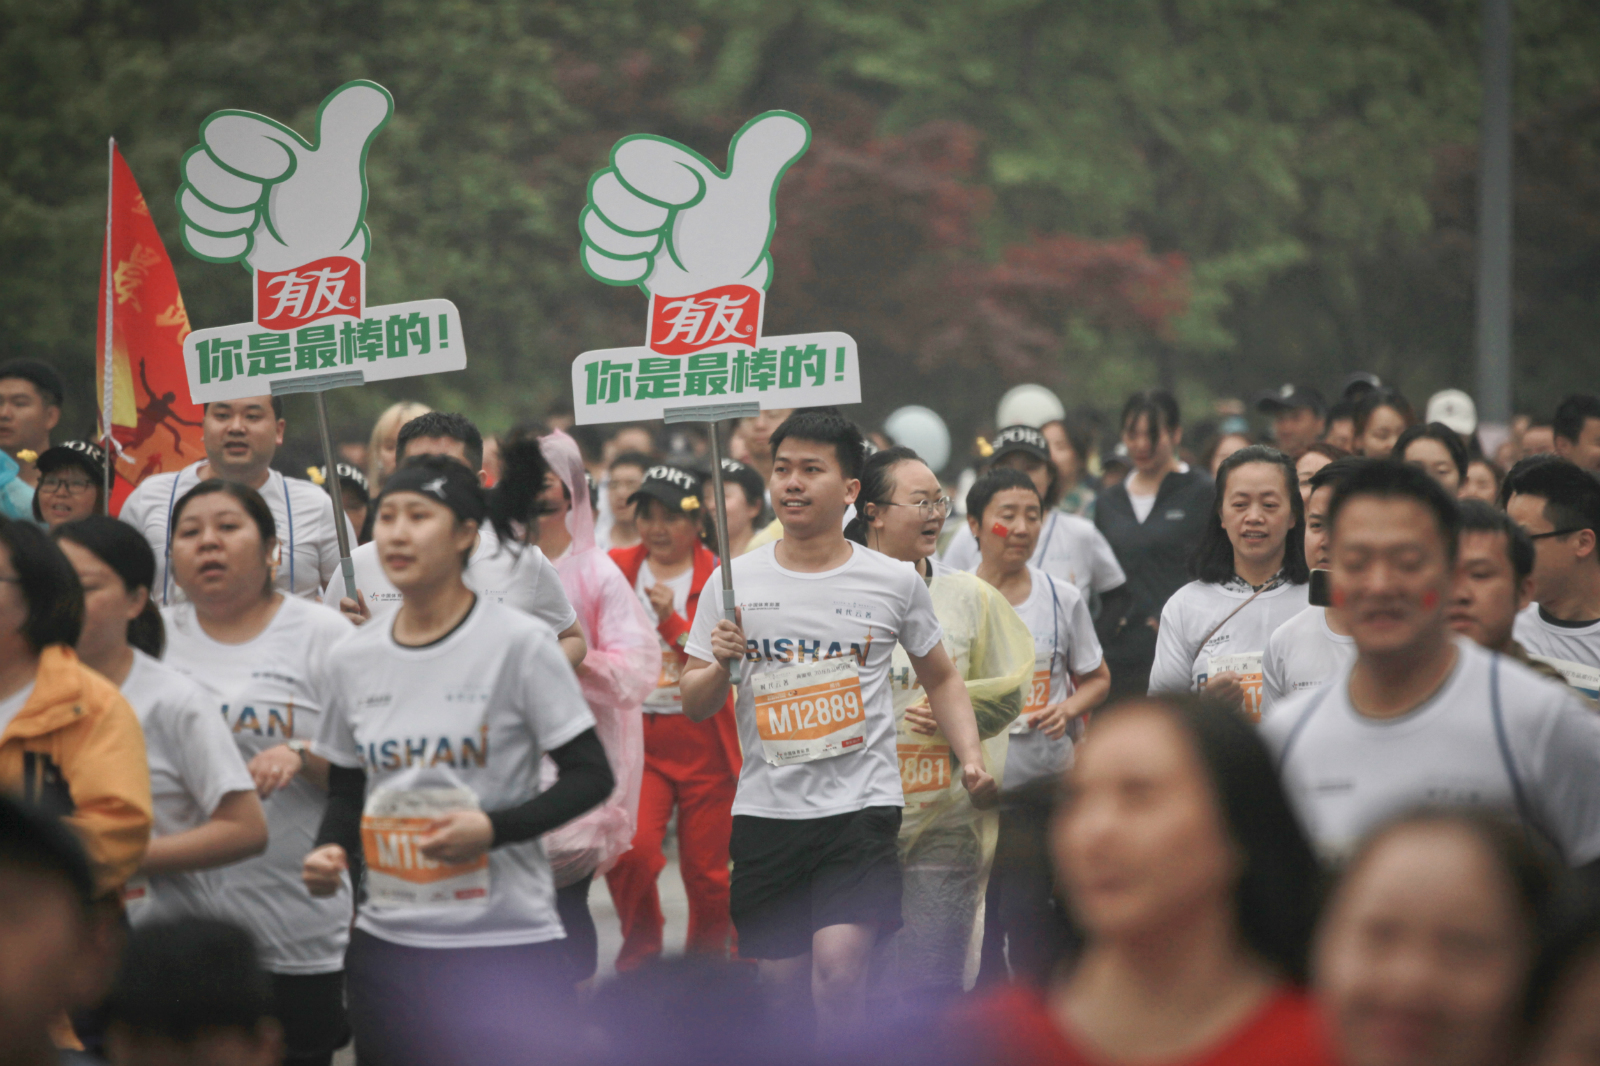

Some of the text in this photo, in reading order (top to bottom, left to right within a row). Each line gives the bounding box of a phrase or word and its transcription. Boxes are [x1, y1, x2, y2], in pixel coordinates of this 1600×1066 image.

[261, 265, 355, 320] 有友
[653, 294, 751, 346] 有友
[195, 312, 449, 385] 你是最棒的!
[584, 344, 846, 406] 你是最棒的!
[745, 626, 873, 667] BISHAN
[768, 691, 860, 735] M12889
[898, 757, 945, 785] 881
